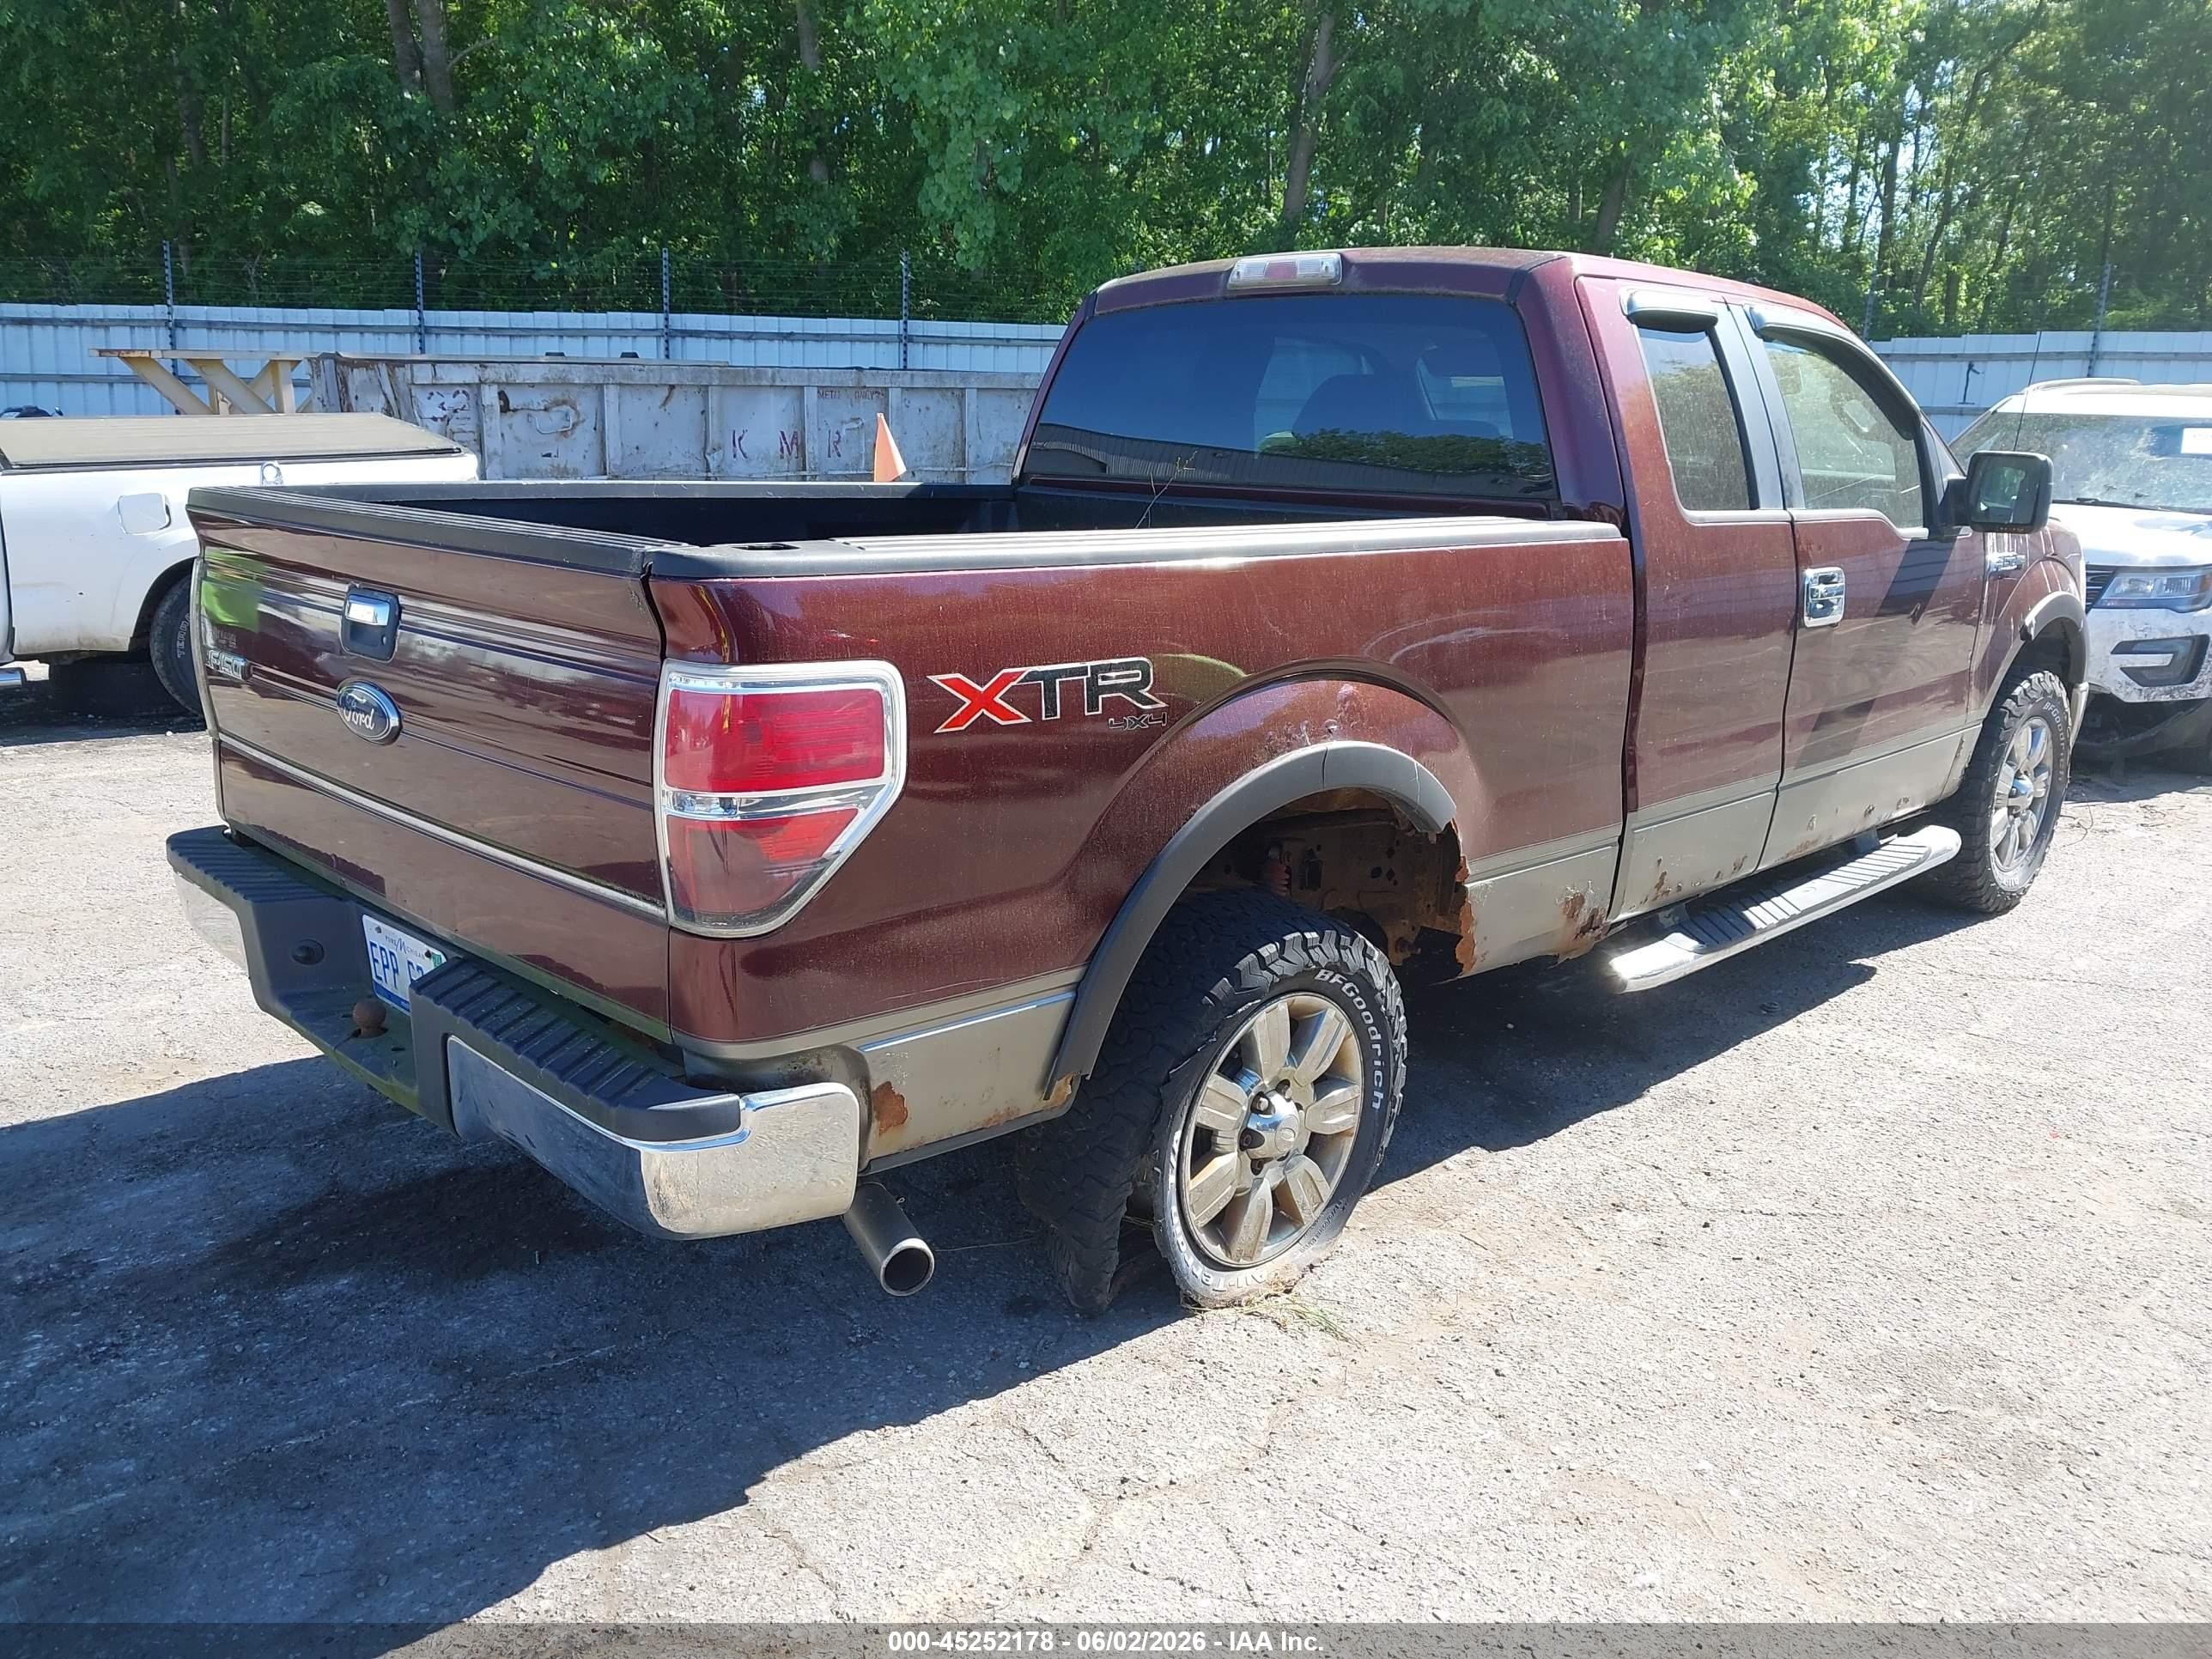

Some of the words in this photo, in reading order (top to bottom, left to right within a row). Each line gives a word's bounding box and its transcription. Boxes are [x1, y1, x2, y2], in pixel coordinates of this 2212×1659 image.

[343, 692, 375, 730] Ford
[926, 656, 1170, 735] XTR
[369, 940, 400, 991] EPP
[1315, 969, 1384, 1110] BFGoodrich
